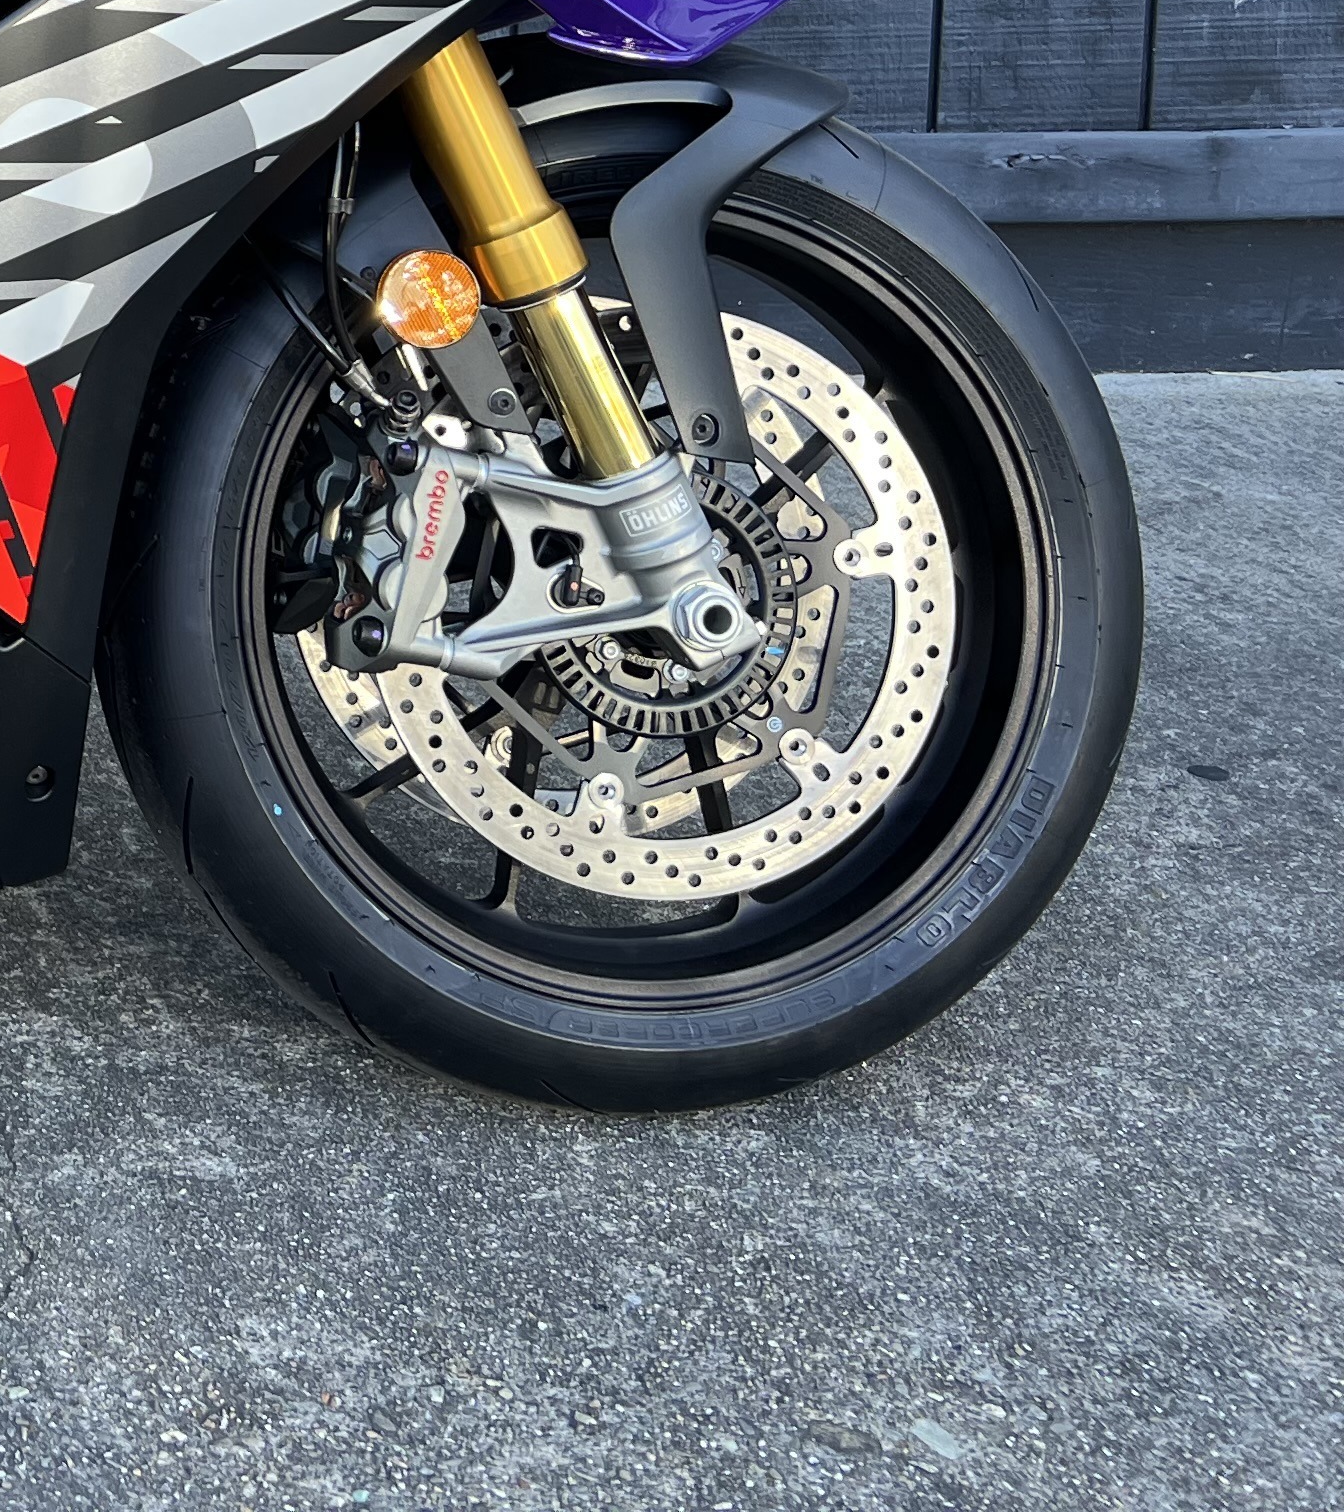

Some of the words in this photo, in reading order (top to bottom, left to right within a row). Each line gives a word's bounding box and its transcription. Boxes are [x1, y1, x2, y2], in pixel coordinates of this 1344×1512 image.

[415, 470, 450, 561] brembo
[625, 492, 690, 532] ÖHLINS
[916, 774, 1055, 948] DIABLO
